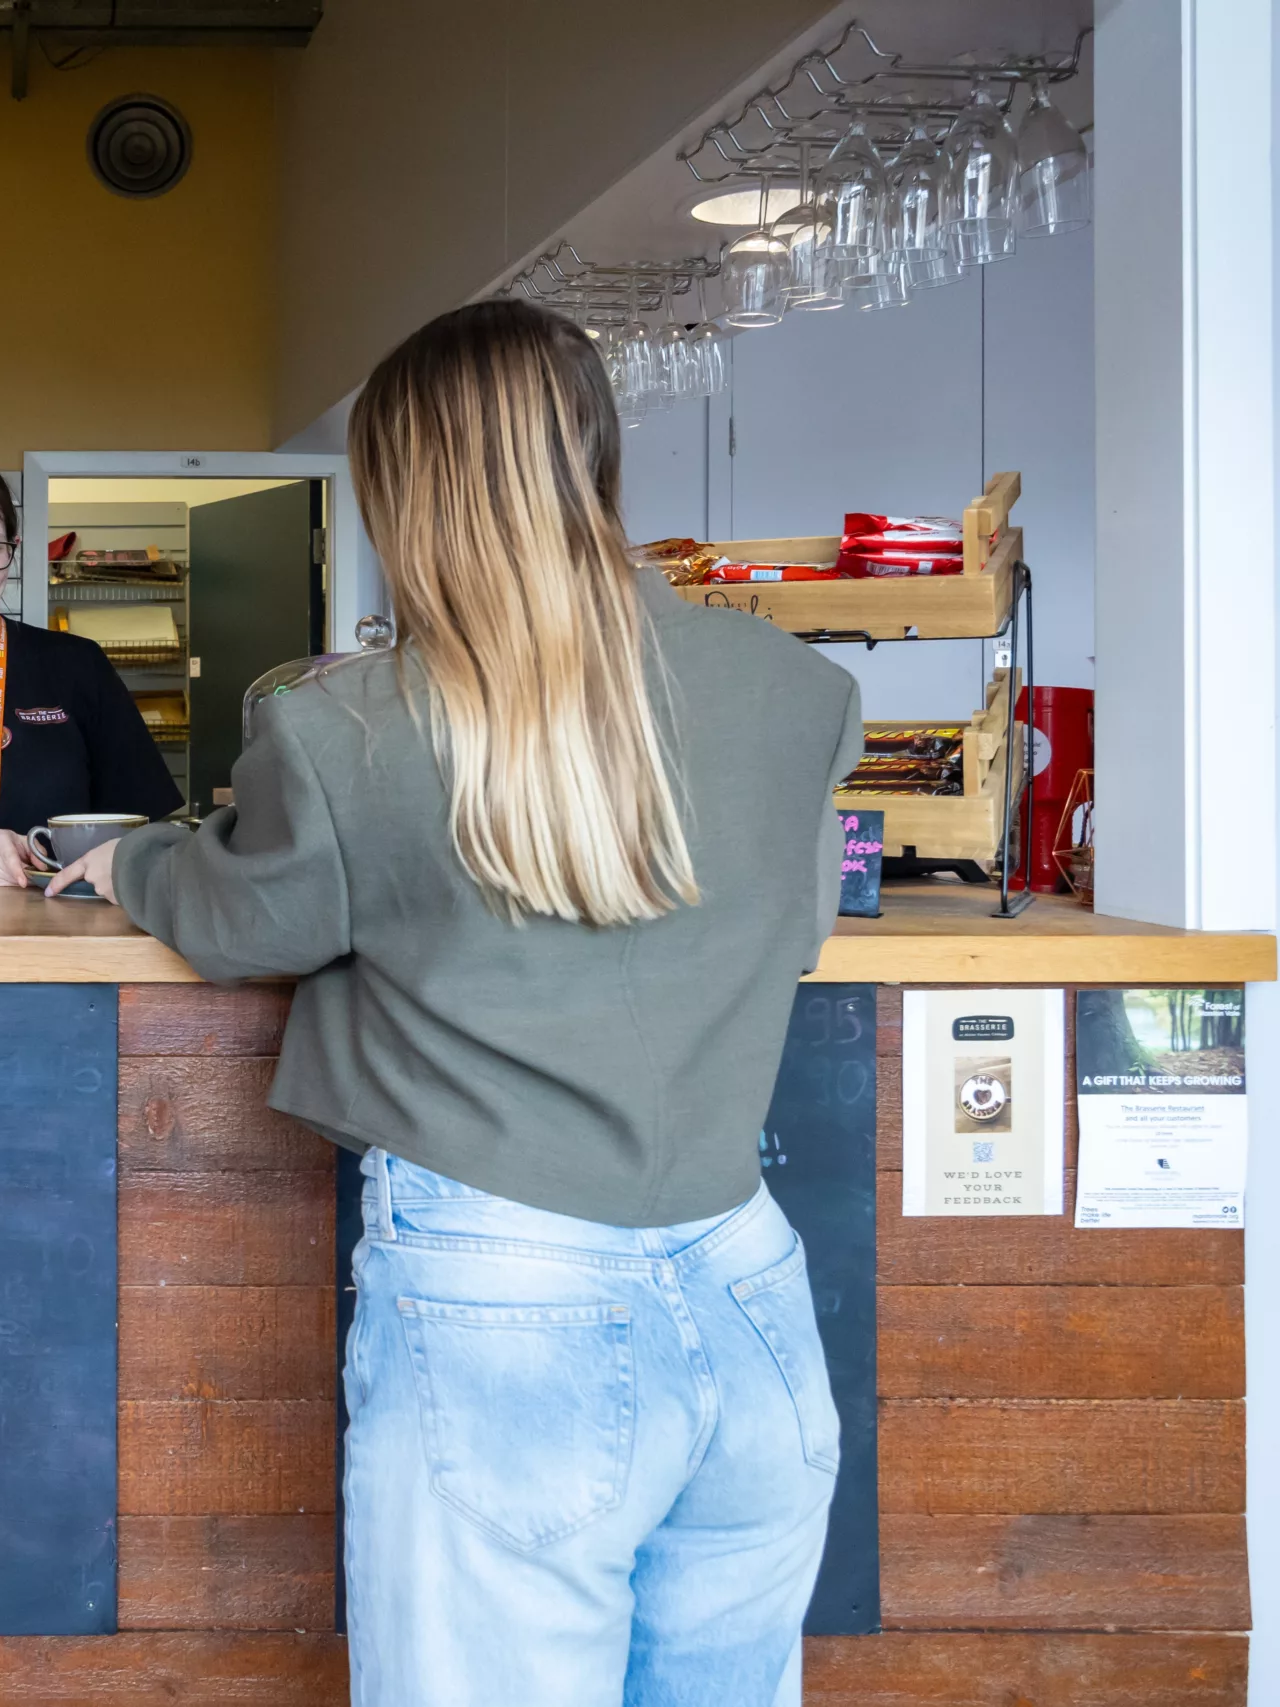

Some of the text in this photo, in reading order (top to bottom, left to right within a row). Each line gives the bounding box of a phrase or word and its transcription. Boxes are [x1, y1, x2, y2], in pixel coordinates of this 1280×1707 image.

[20, 712, 67, 721] BRASSERIE
[1082, 1075, 1242, 1086] A GIFT THAT KEEPS GROWING
[944, 1171, 1023, 1179] WE'D LOVE
[963, 1184, 1003, 1192] YOUR
[944, 1196, 1022, 1204] FEEDBACK
